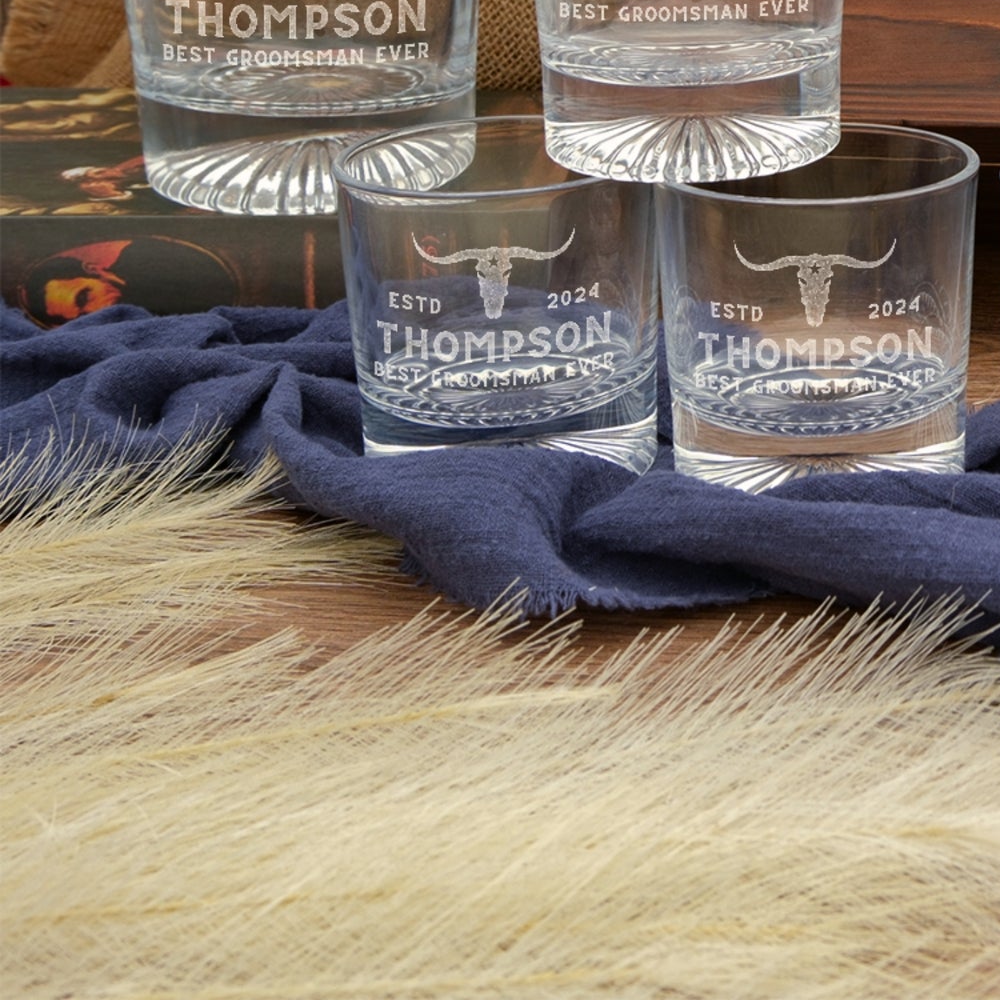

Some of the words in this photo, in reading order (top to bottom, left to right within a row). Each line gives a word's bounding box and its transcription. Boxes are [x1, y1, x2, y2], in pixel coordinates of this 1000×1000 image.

[559, 2, 608, 21] BEST
[618, 3, 747, 22] GROOMSMAN
[162, 43, 215, 64] BEST
[226, 47, 364, 67] GROOMSMAN
[376, 42, 429, 63] EVER
[389, 291, 441, 314] ESTD
[548, 282, 599, 309] 2024
[711, 301, 763, 322] ESTD
[868, 295, 920, 319] 2024
[377, 311, 611, 363] THOMPSON
[698, 326, 933, 369] THOMPSON
[374, 361, 421, 384] BEST
[696, 373, 743, 391] BEST
